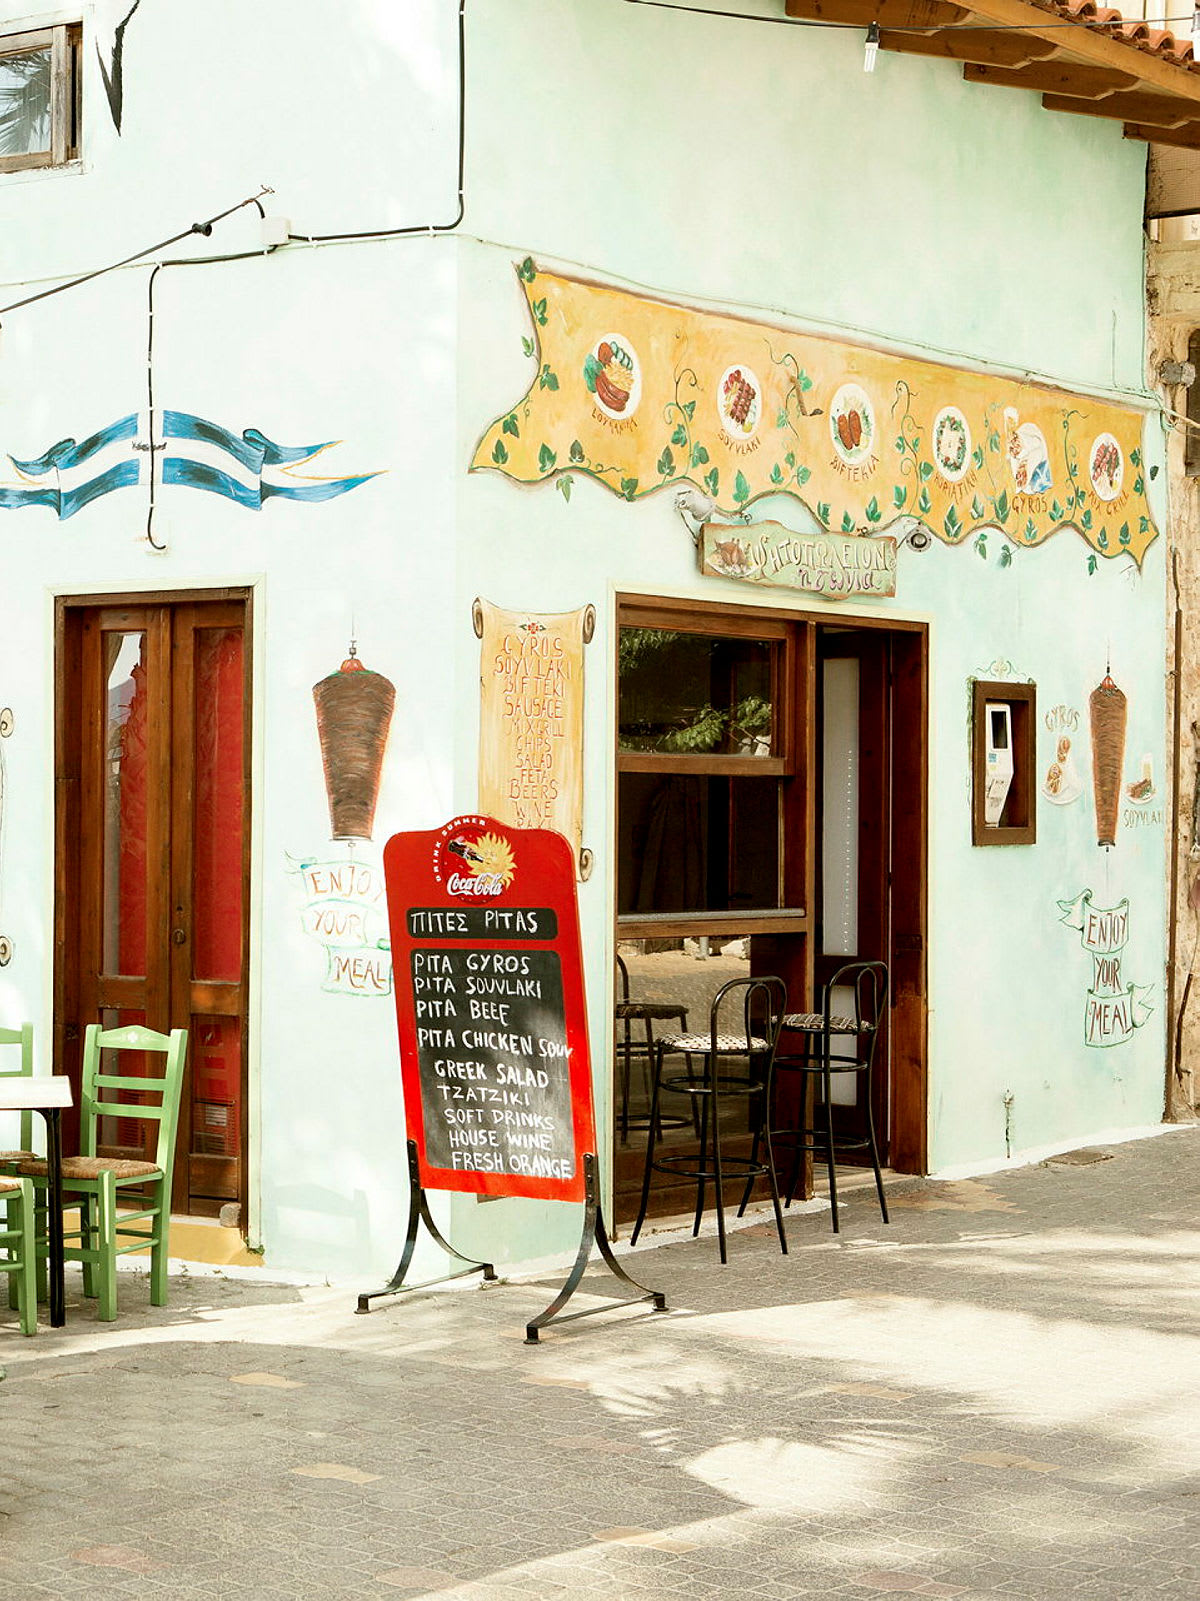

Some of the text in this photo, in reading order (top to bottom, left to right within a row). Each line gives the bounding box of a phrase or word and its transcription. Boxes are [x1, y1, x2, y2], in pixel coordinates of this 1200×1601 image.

[1011, 495, 1048, 515] GYROS
[501, 634, 563, 658] GYROS
[503, 675, 565, 697] BIFTEKI
[1044, 704, 1081, 733] GYROS
[515, 735, 552, 753] CHIPS
[515, 752, 553, 769] SALAD
[520, 768, 548, 784] FETA
[509, 778, 558, 800] BEERS
[511, 800, 553, 818] WINE
[441, 817, 486, 837] SUMMER
[446, 872, 503, 896] Coca-Cola
[313, 909, 362, 939] YOUR
[410, 909, 538, 934] ΠΙΤΕΣ PITAS
[1085, 912, 1128, 953] ENJOY
[333, 956, 387, 989] MEAL
[414, 953, 531, 975] PITA GYROS
[1094, 957, 1123, 994] YOUR
[414, 976, 542, 1000] PITA SOUVLAKI
[416, 998, 510, 1027] PITA BEEF
[1088, 1000, 1133, 1043] MEAL
[417, 1027, 456, 1049] PITA
[461, 1029, 534, 1057] CHICKEN
[434, 1059, 549, 1089] GREEK SALAD
[436, 1084, 531, 1107] TZATZIKI
[443, 1108, 556, 1131] SOFT DRINKS
[448, 1129, 552, 1152] HOUSE WINE
[451, 1151, 573, 1180] FRESH ORANGE
